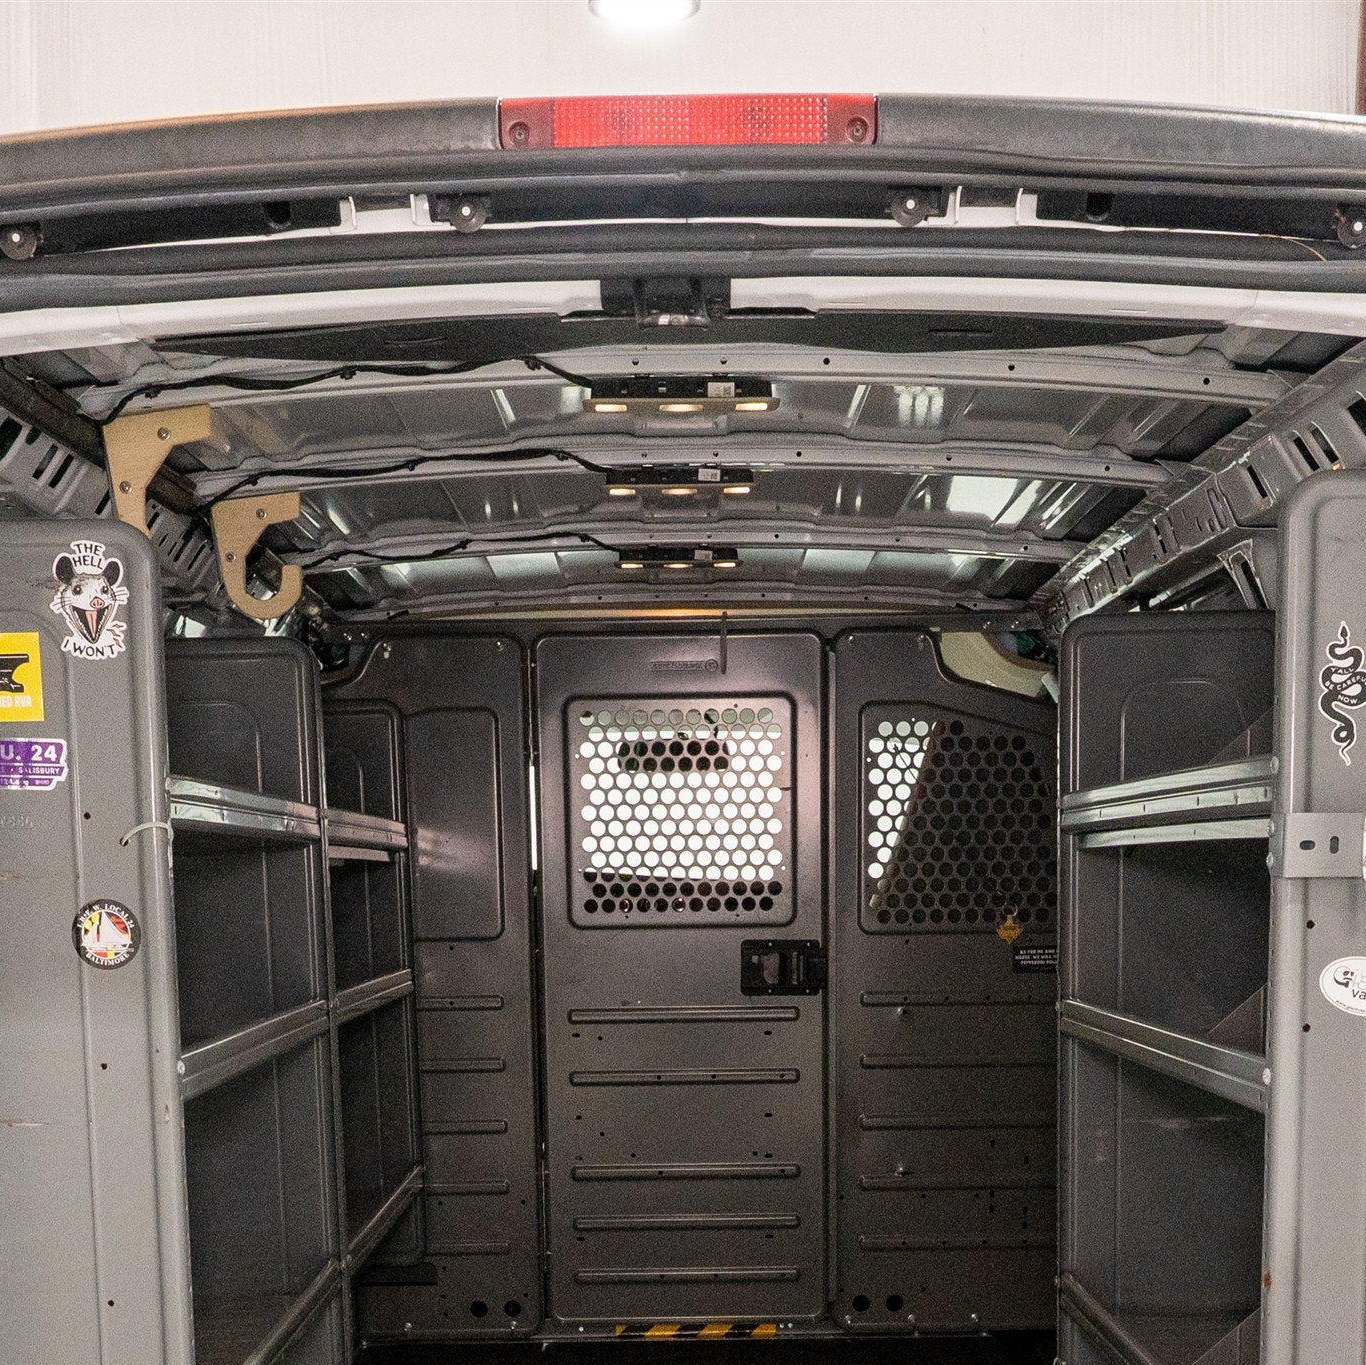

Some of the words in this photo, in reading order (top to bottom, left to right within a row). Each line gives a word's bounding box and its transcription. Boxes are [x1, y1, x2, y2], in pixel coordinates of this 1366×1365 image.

[74, 543, 103, 555] THE
[72, 555, 104, 570] HELL
[63, 639, 70, 649] I
[1330, 667, 1355, 675] Y'ALL
[1324, 680, 1335, 691] BE
[15, 695, 33, 707] RVA
[1337, 693, 1359, 705] NOW
[31, 744, 58, 761] 24
[104, 903, 129, 921] LOCAL
[126, 919, 135, 929] 24
[85, 951, 130, 966] BALTIMORE
